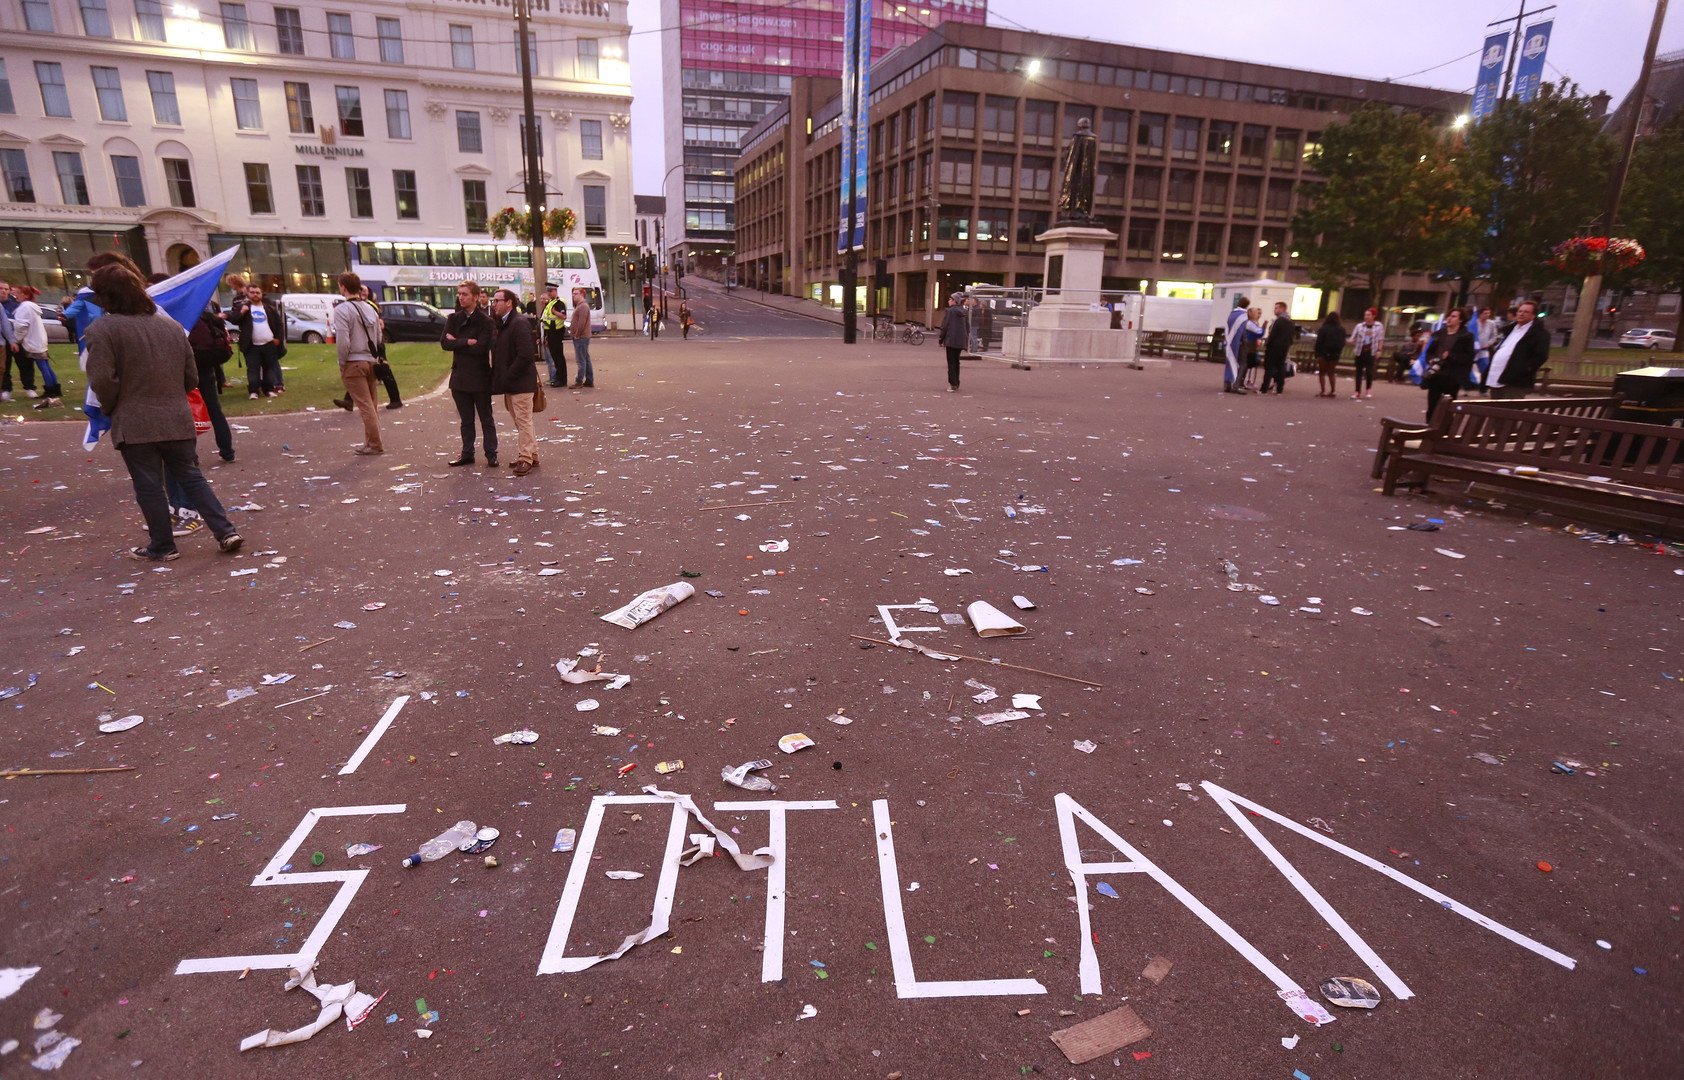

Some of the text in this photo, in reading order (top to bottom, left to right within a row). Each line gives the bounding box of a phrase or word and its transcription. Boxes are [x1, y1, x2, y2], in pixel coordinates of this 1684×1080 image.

[295, 145, 364, 157] MILLENNIUM
[429, 271, 463, 281] £100M
[466, 272, 477, 281] IN
[480, 273, 515, 282] PRIZES
